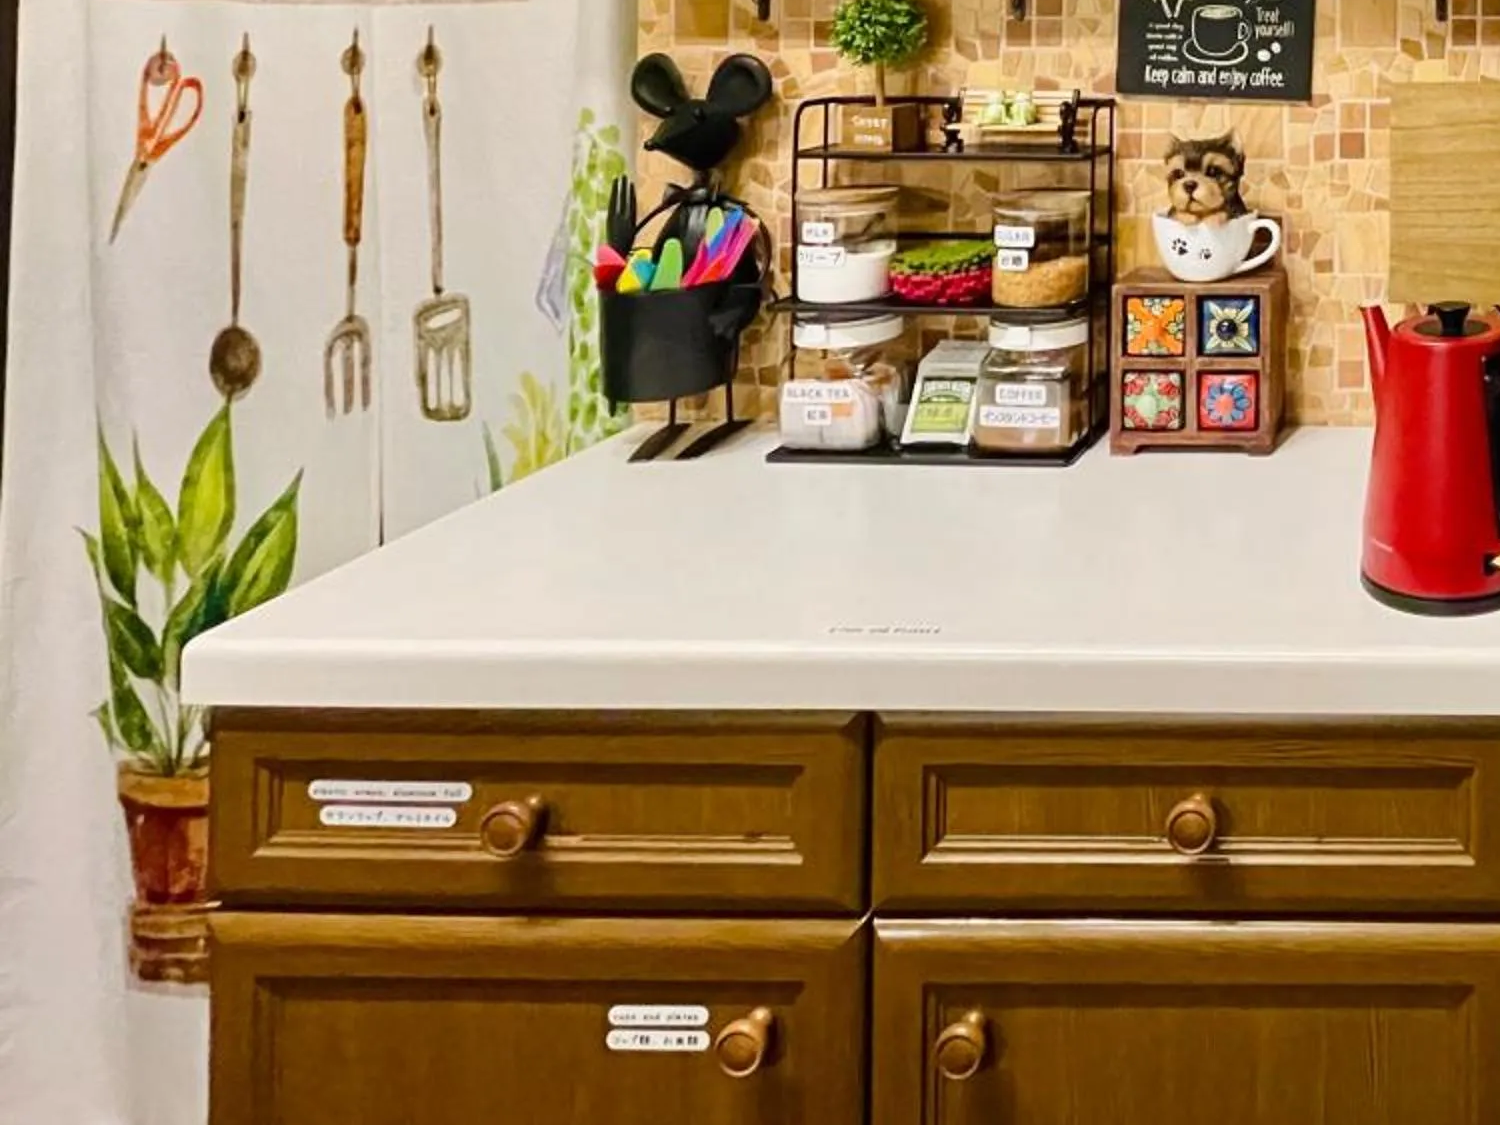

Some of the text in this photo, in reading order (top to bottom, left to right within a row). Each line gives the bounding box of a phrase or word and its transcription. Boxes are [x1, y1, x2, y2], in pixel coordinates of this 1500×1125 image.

[1256, 6, 1280, 23] Treat
[1144, 65, 1169, 88] Keep
[1171, 65, 1195, 84] calm
[1198, 66, 1217, 85] and
[1219, 67, 1248, 90] enjoy
[1000, 387, 1043, 401] COFFEE
